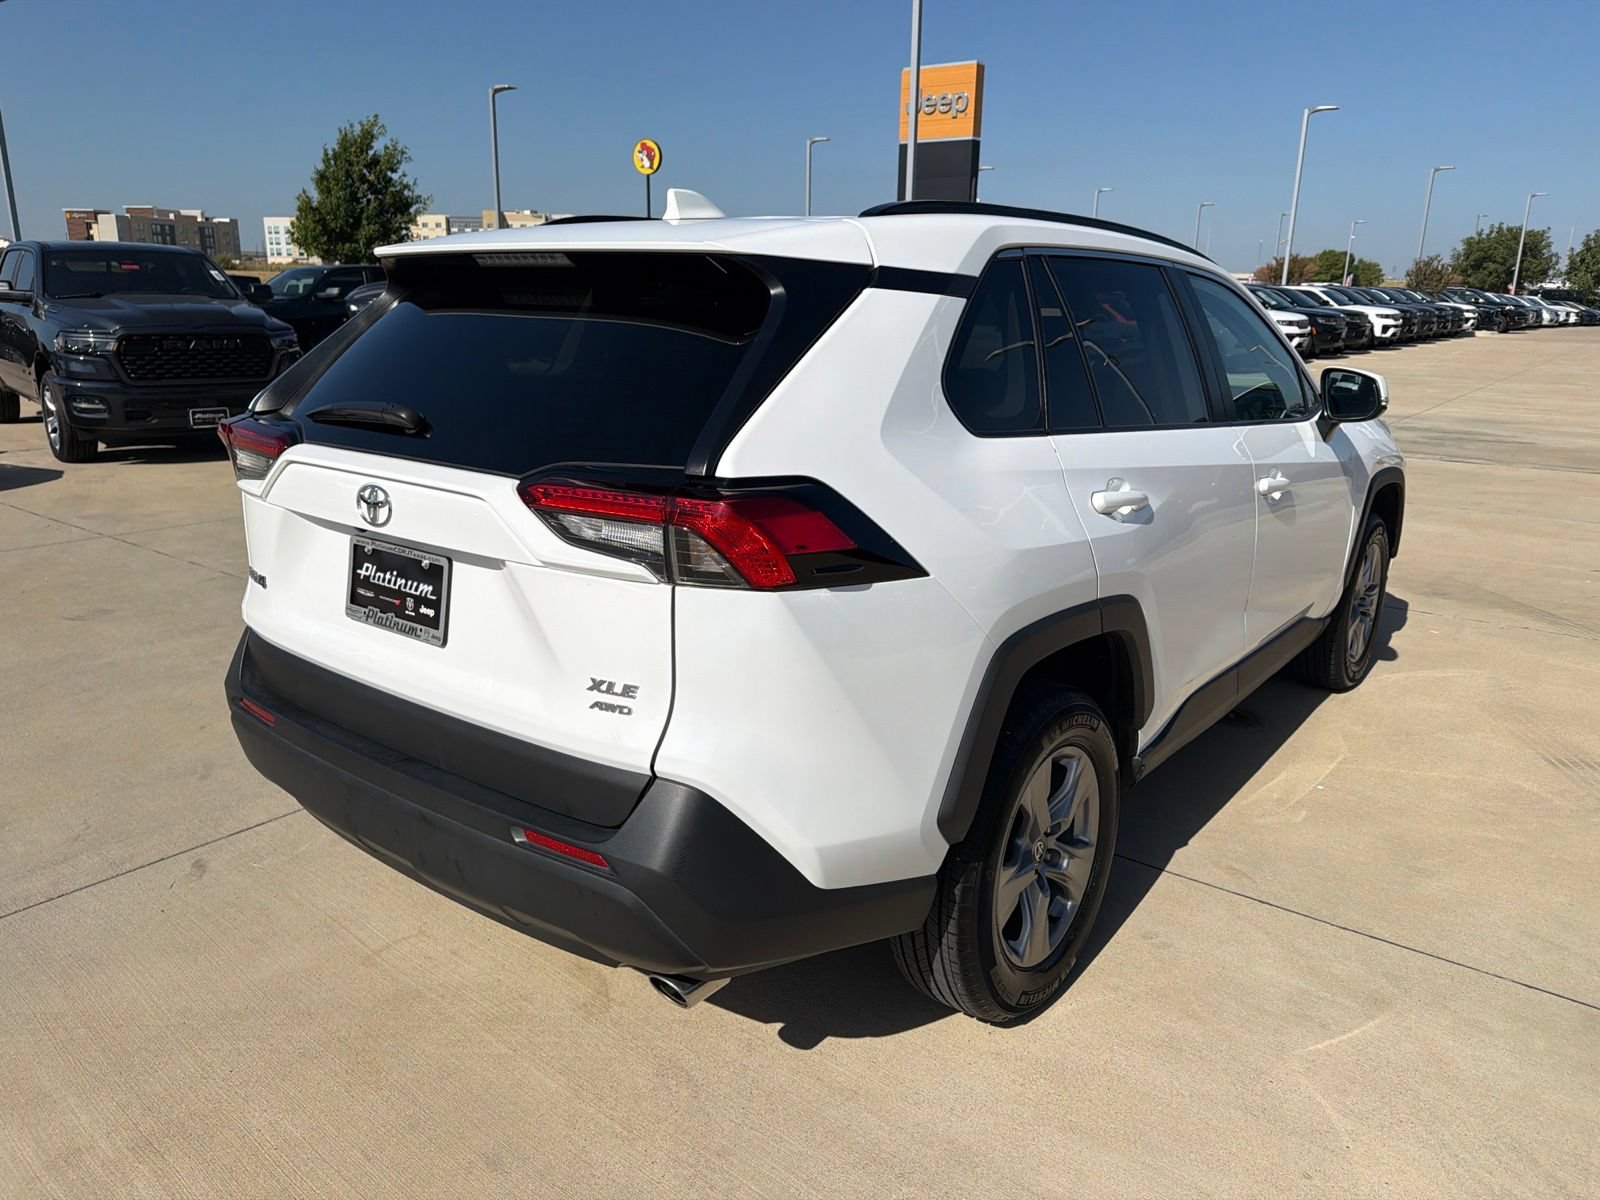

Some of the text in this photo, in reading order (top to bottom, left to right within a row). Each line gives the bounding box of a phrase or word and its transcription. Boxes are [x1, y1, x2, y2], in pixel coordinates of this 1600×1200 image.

[356, 562, 437, 600] Platinum
[419, 604, 435, 618] Jeep
[366, 608, 421, 638] Platinum
[586, 677, 639, 699] XLE
[589, 701, 632, 716] AWD
[1062, 714, 1100, 730] MICHELIN
